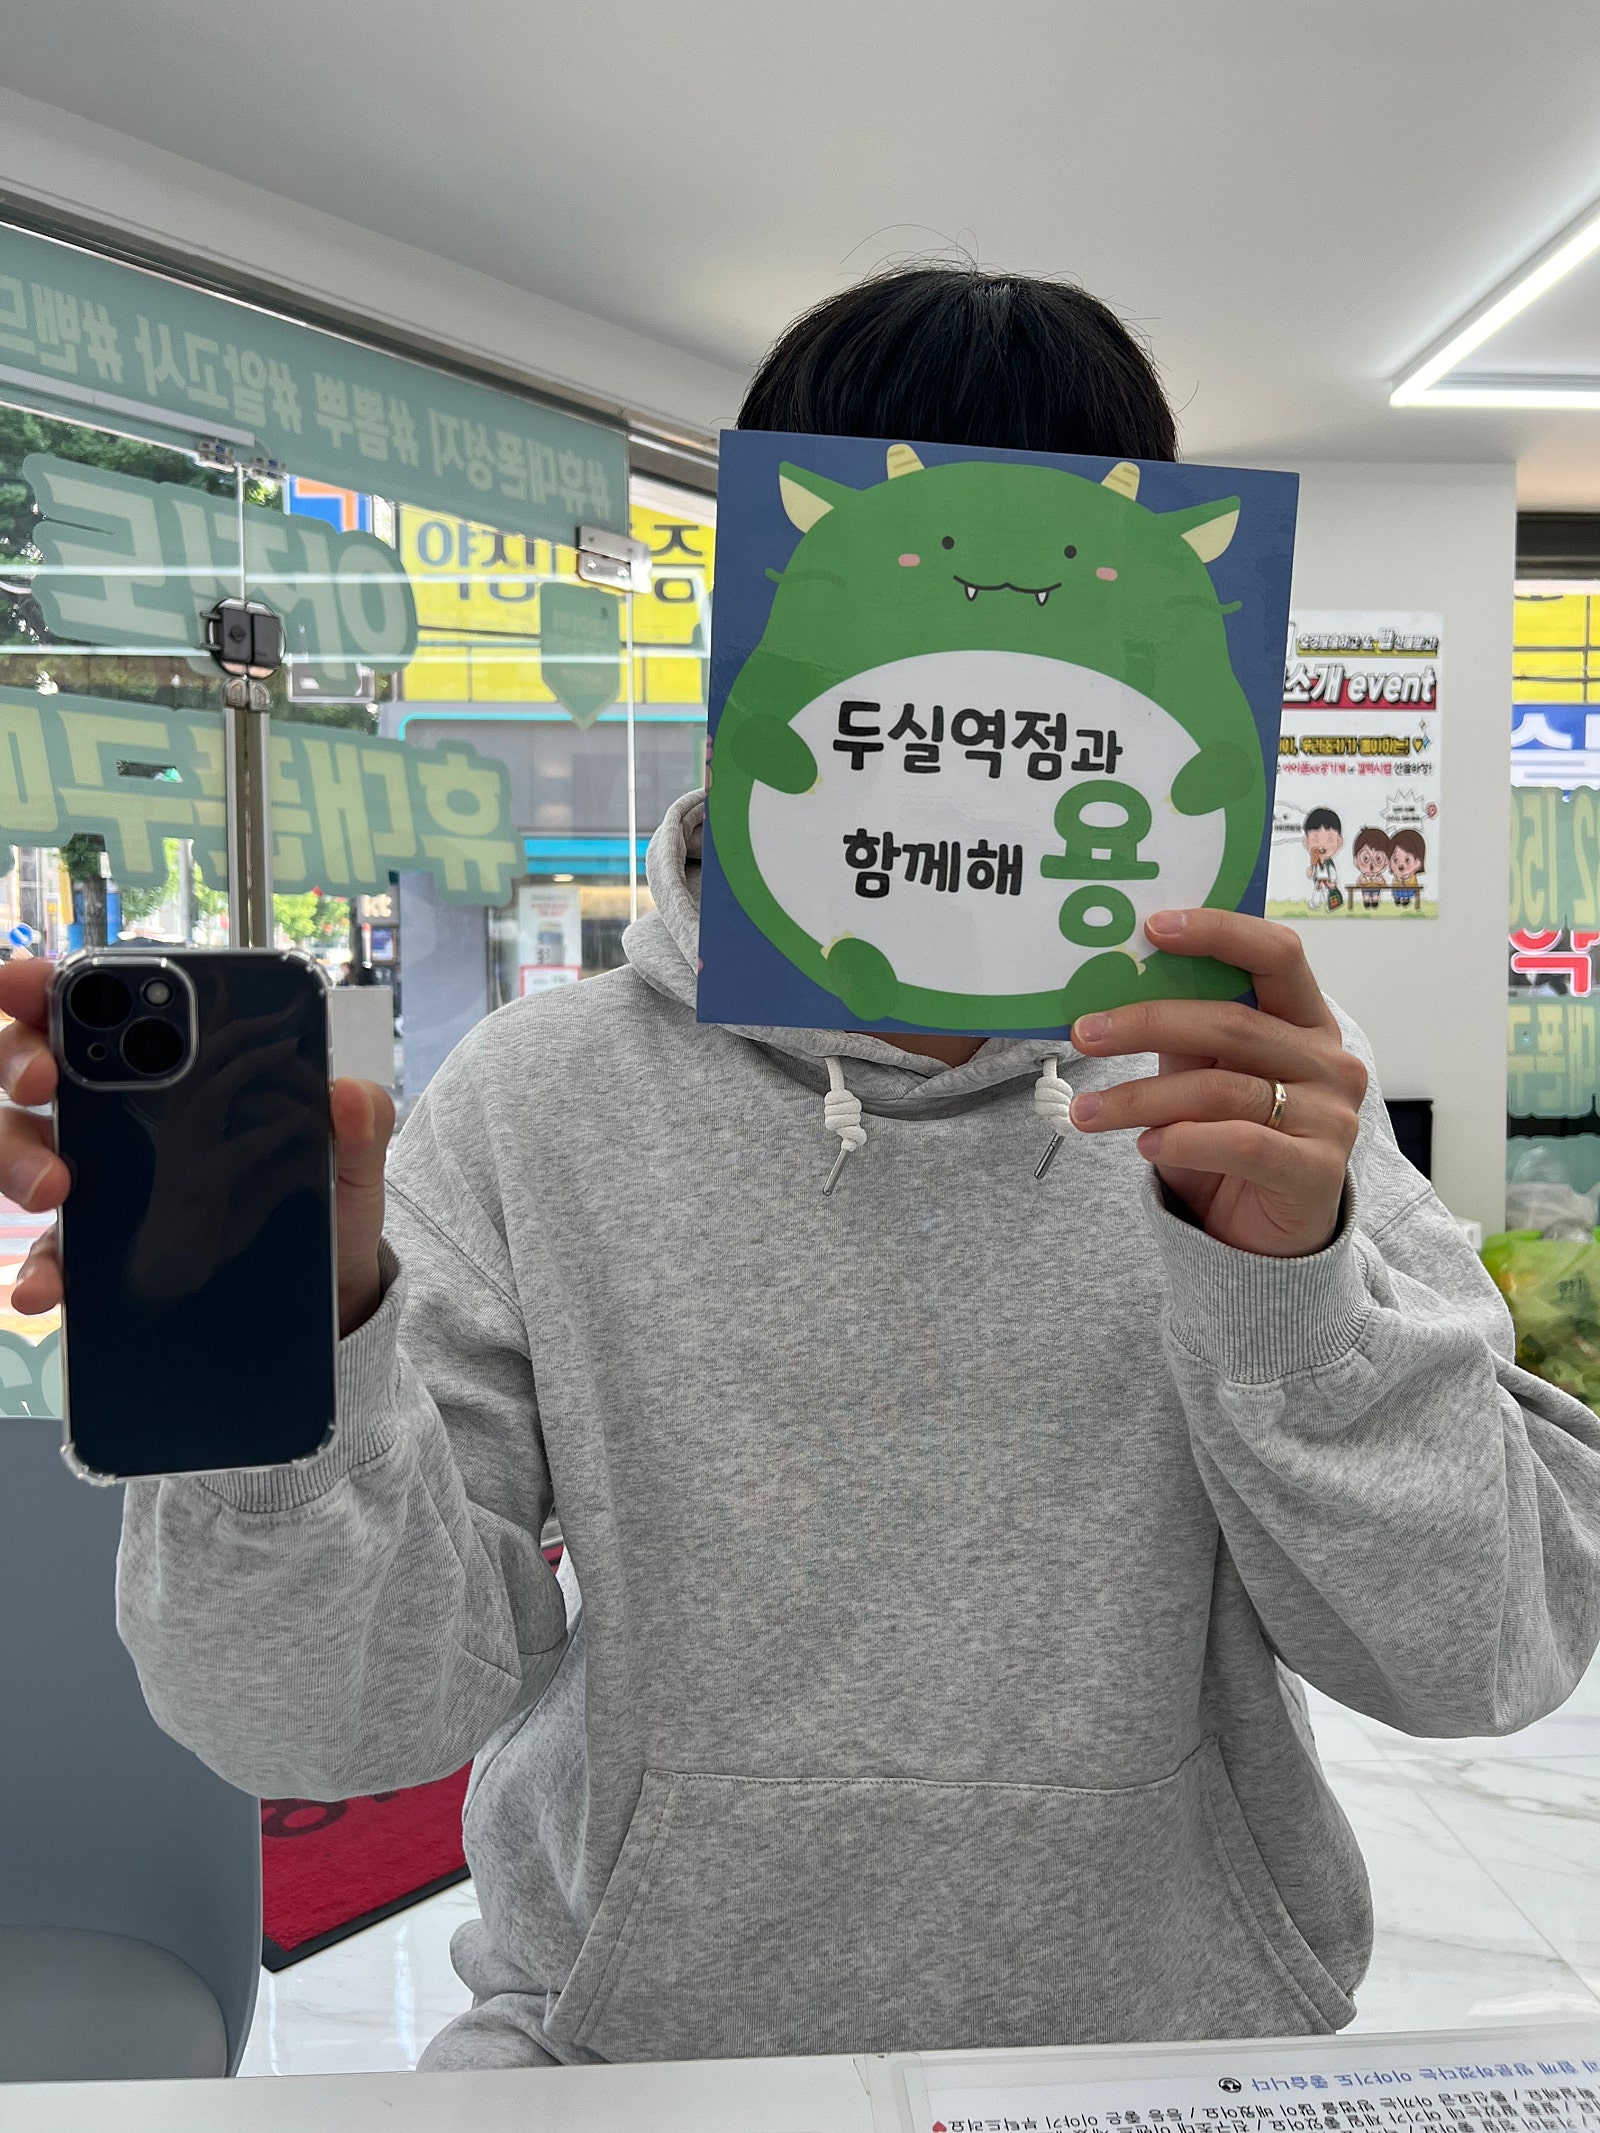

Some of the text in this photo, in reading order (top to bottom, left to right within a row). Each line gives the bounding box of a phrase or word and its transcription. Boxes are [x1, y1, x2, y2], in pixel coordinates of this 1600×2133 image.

[1346, 664, 1437, 704] event
[832, 700, 1123, 781] 두실역점과
[1251, 2074, 1328, 2092] 좋습니다
[1333, 2070, 1412, 2087] 이야기도
[1279, 2103, 1316, 2117] 많이
[1321, 2099, 1375, 2115] 방법을
[1379, 2095, 1433, 2110] 아끼는
[1202, 2105, 1274, 2119] 배웠어요
[1045, 2114, 1098, 2129] 이야기
